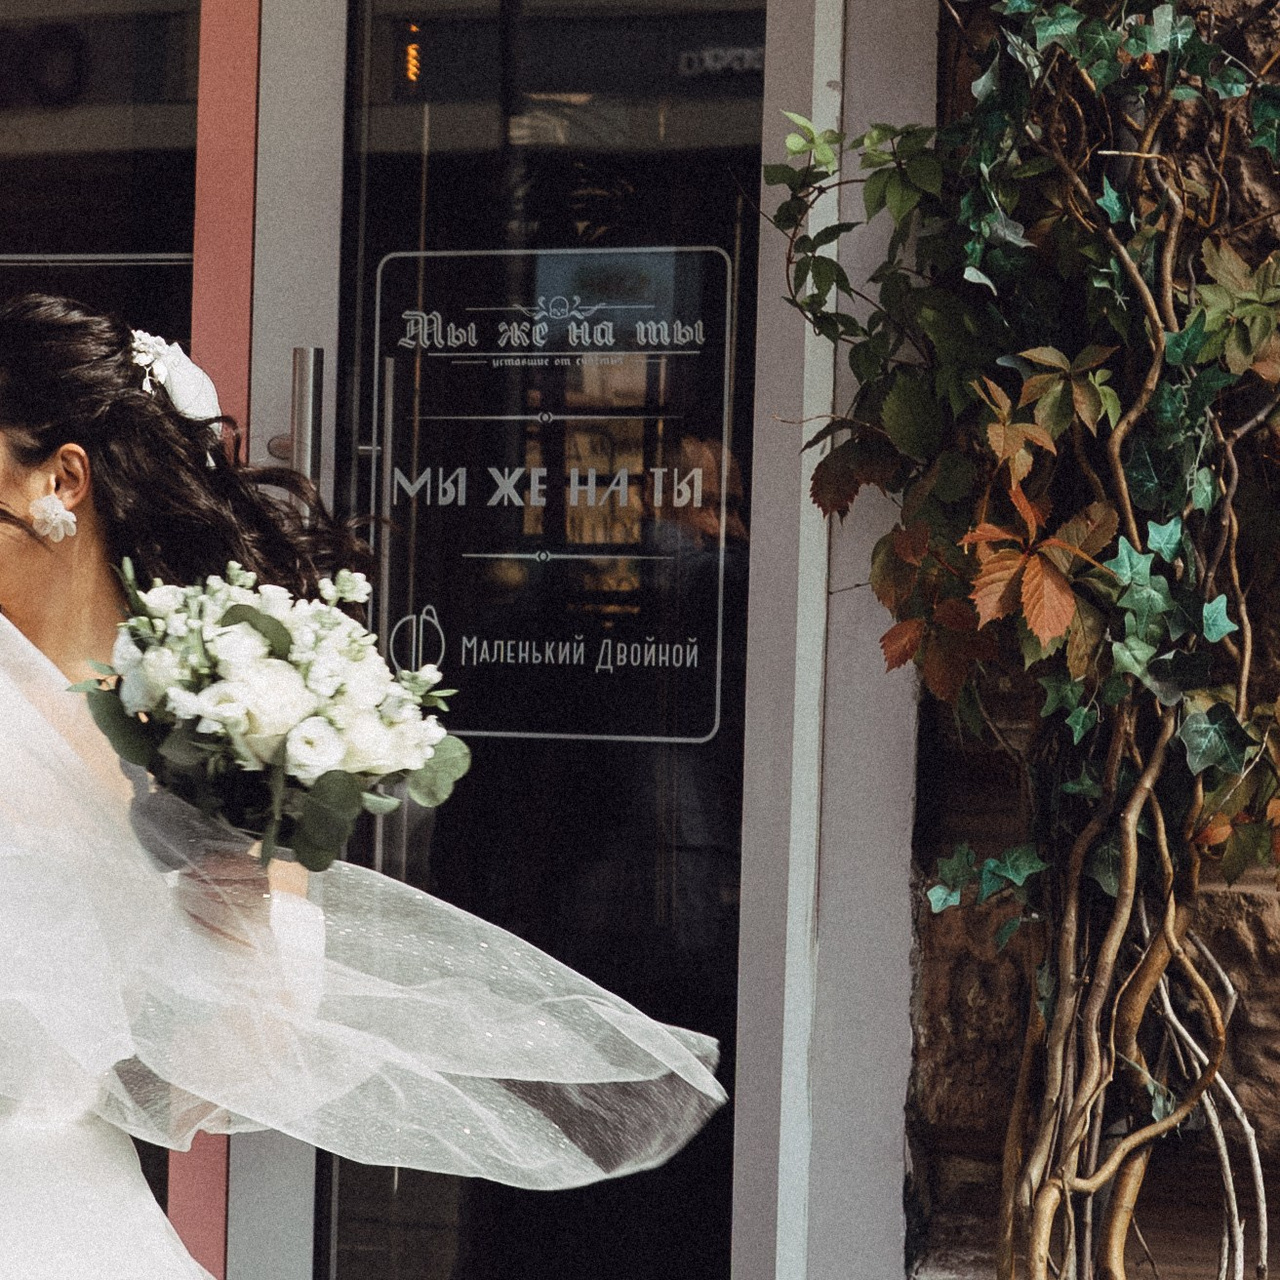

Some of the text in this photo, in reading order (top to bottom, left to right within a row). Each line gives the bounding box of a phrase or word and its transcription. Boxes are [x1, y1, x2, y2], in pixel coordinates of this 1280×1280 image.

[397, 310, 706, 348] Мы же на ты
[393, 467, 703, 508] МЫ ЖЕ НА ТЫ
